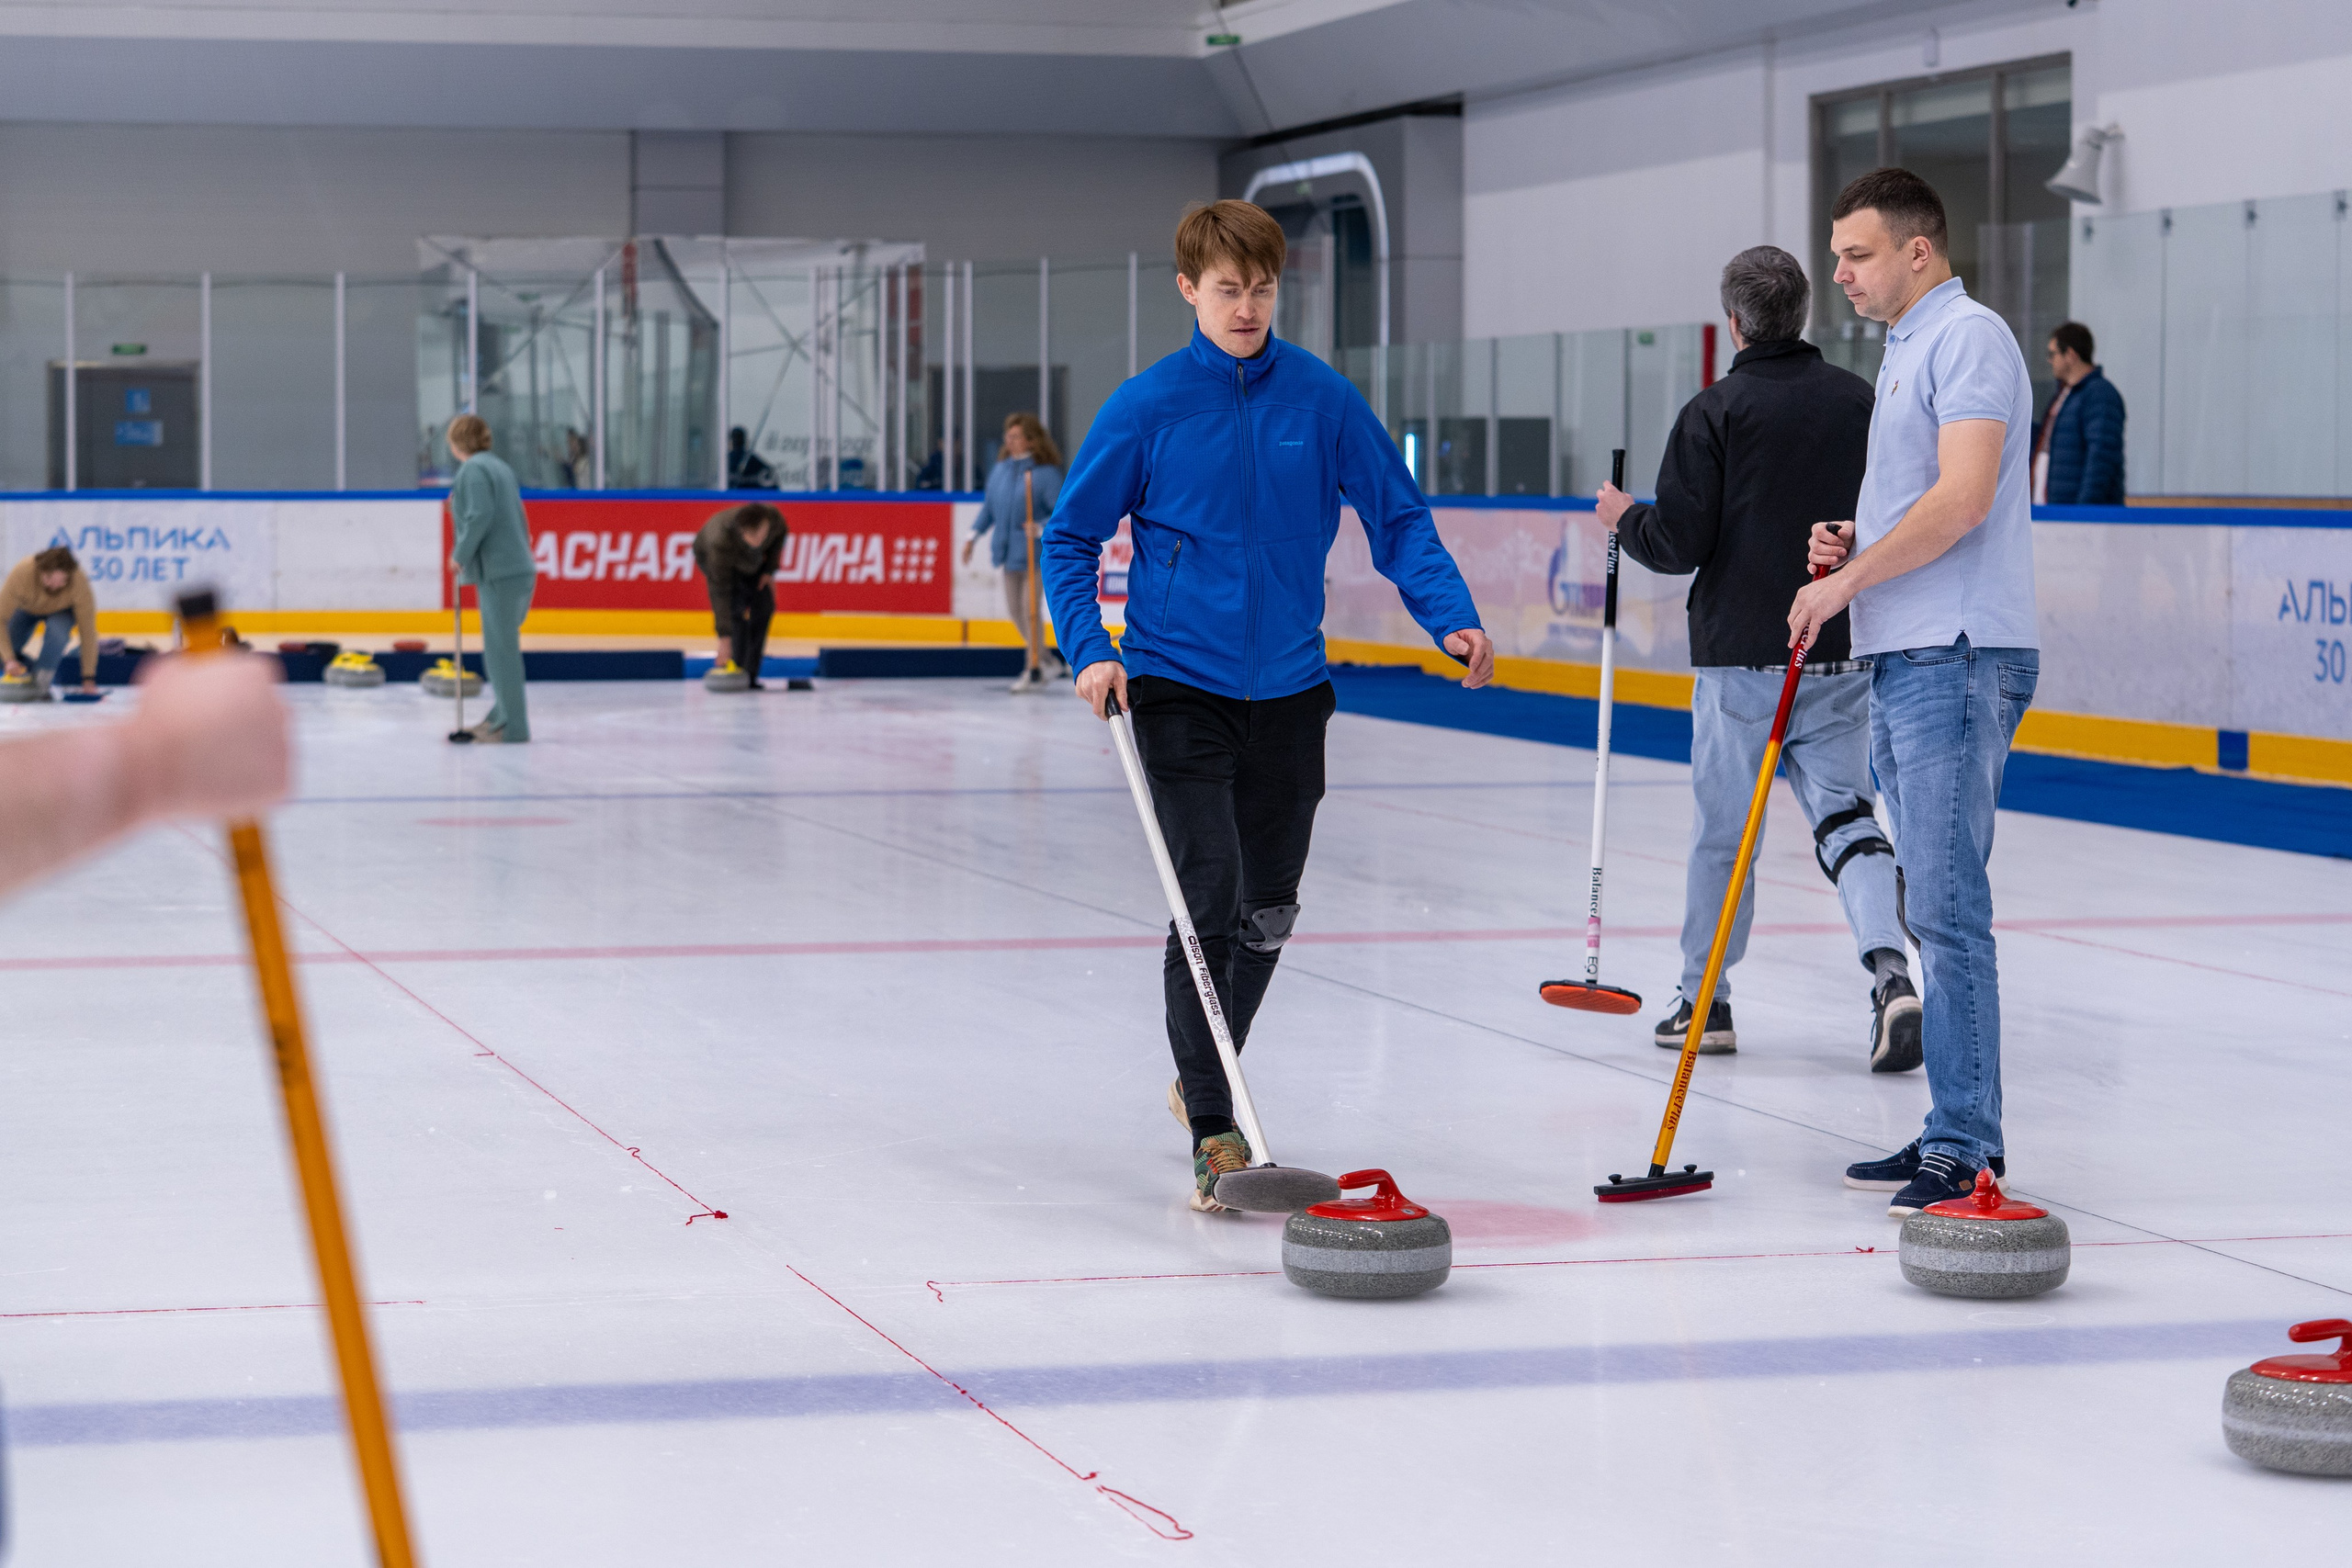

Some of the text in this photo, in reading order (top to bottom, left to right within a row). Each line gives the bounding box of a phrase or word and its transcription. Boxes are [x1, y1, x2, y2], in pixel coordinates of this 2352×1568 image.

[48, 525, 232, 551] АЛЬПИКА
[532, 530, 886, 584] АСНАЯ ШИНА
[1608, 531, 1619, 575] cePlus
[90, 556, 190, 581] 30 ЛЕТ
[2278, 579, 2352, 626] АЛЬ
[2314, 638, 2346, 684] 30
[1590, 867, 1601, 918] Balance
[1200, 967, 1220, 1016] Fiberglass
[1667, 1049, 1698, 1133] BalancePlus
